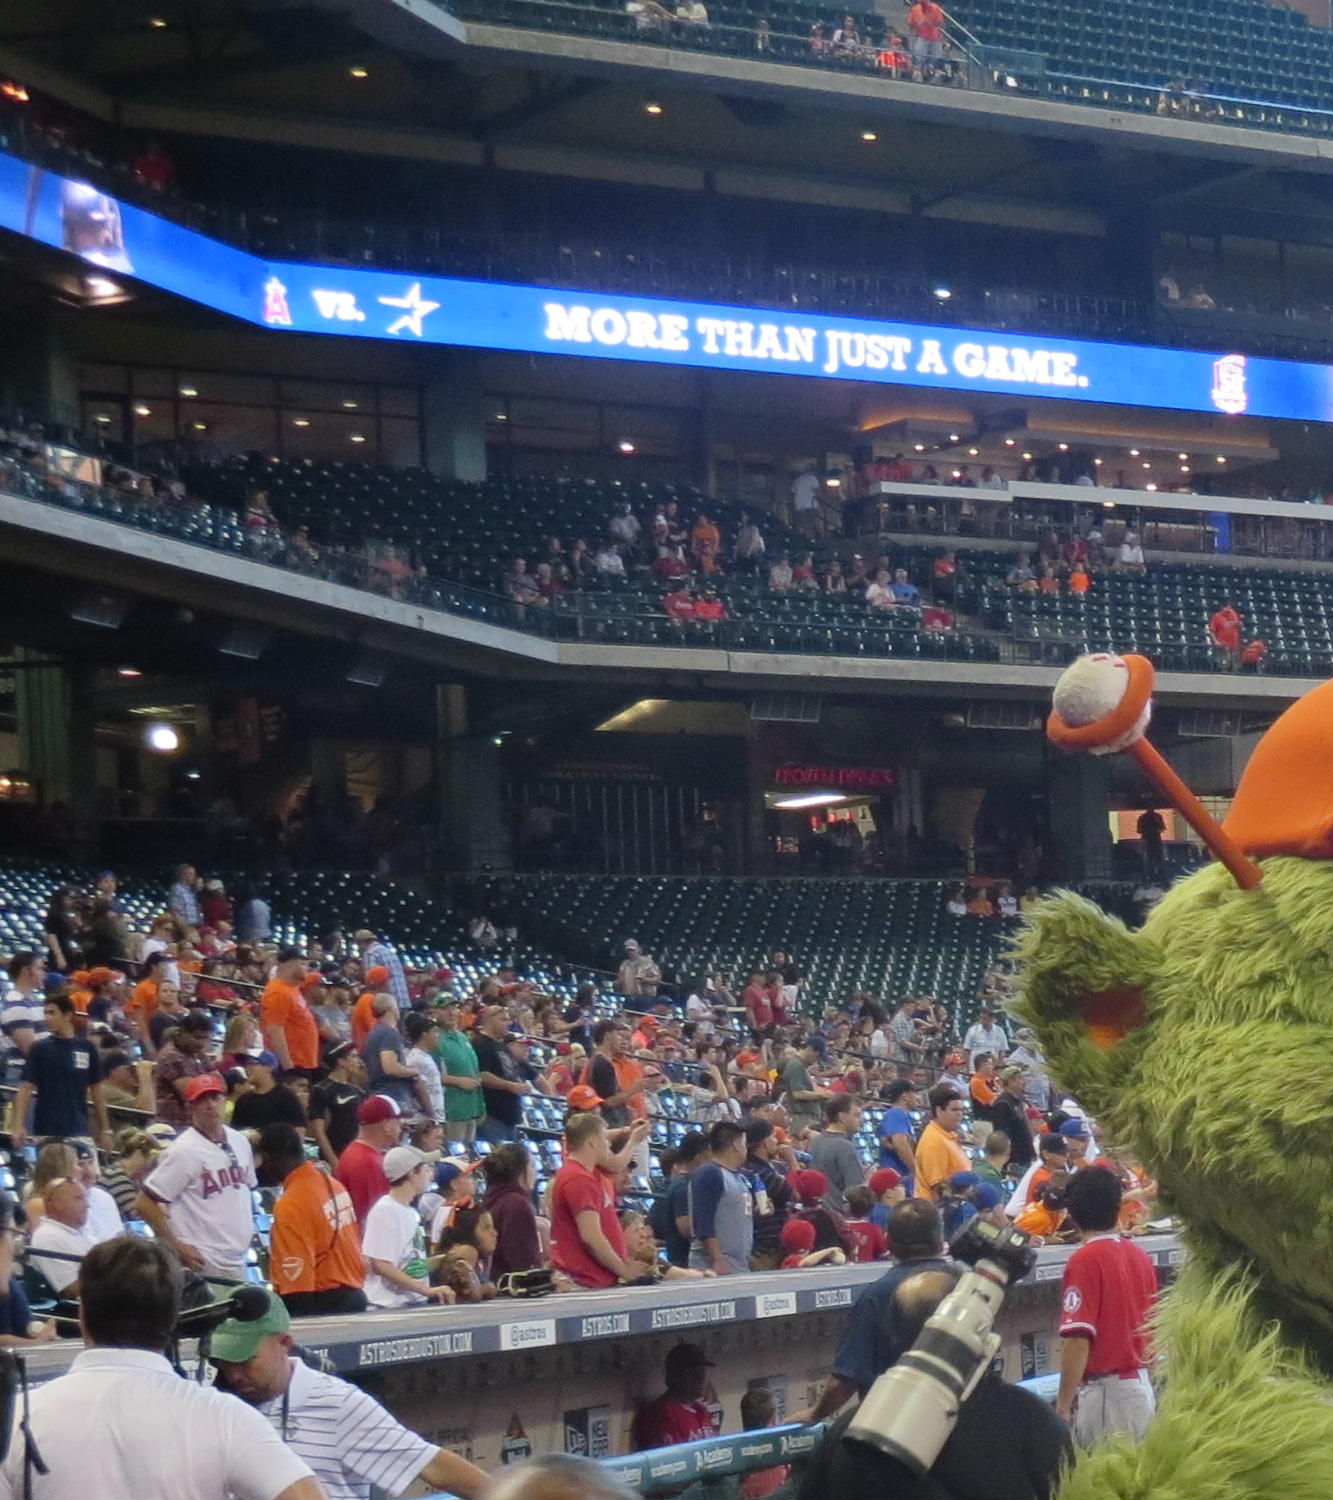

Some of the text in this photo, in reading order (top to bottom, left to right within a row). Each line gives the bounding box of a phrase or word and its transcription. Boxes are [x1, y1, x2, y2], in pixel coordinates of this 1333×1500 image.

[543, 303, 1090, 388] MORE THAN JUST A GAME.
[511, 1325, 548, 1347] @astros
[581, 1312, 630, 1338] ASTROS.COM
